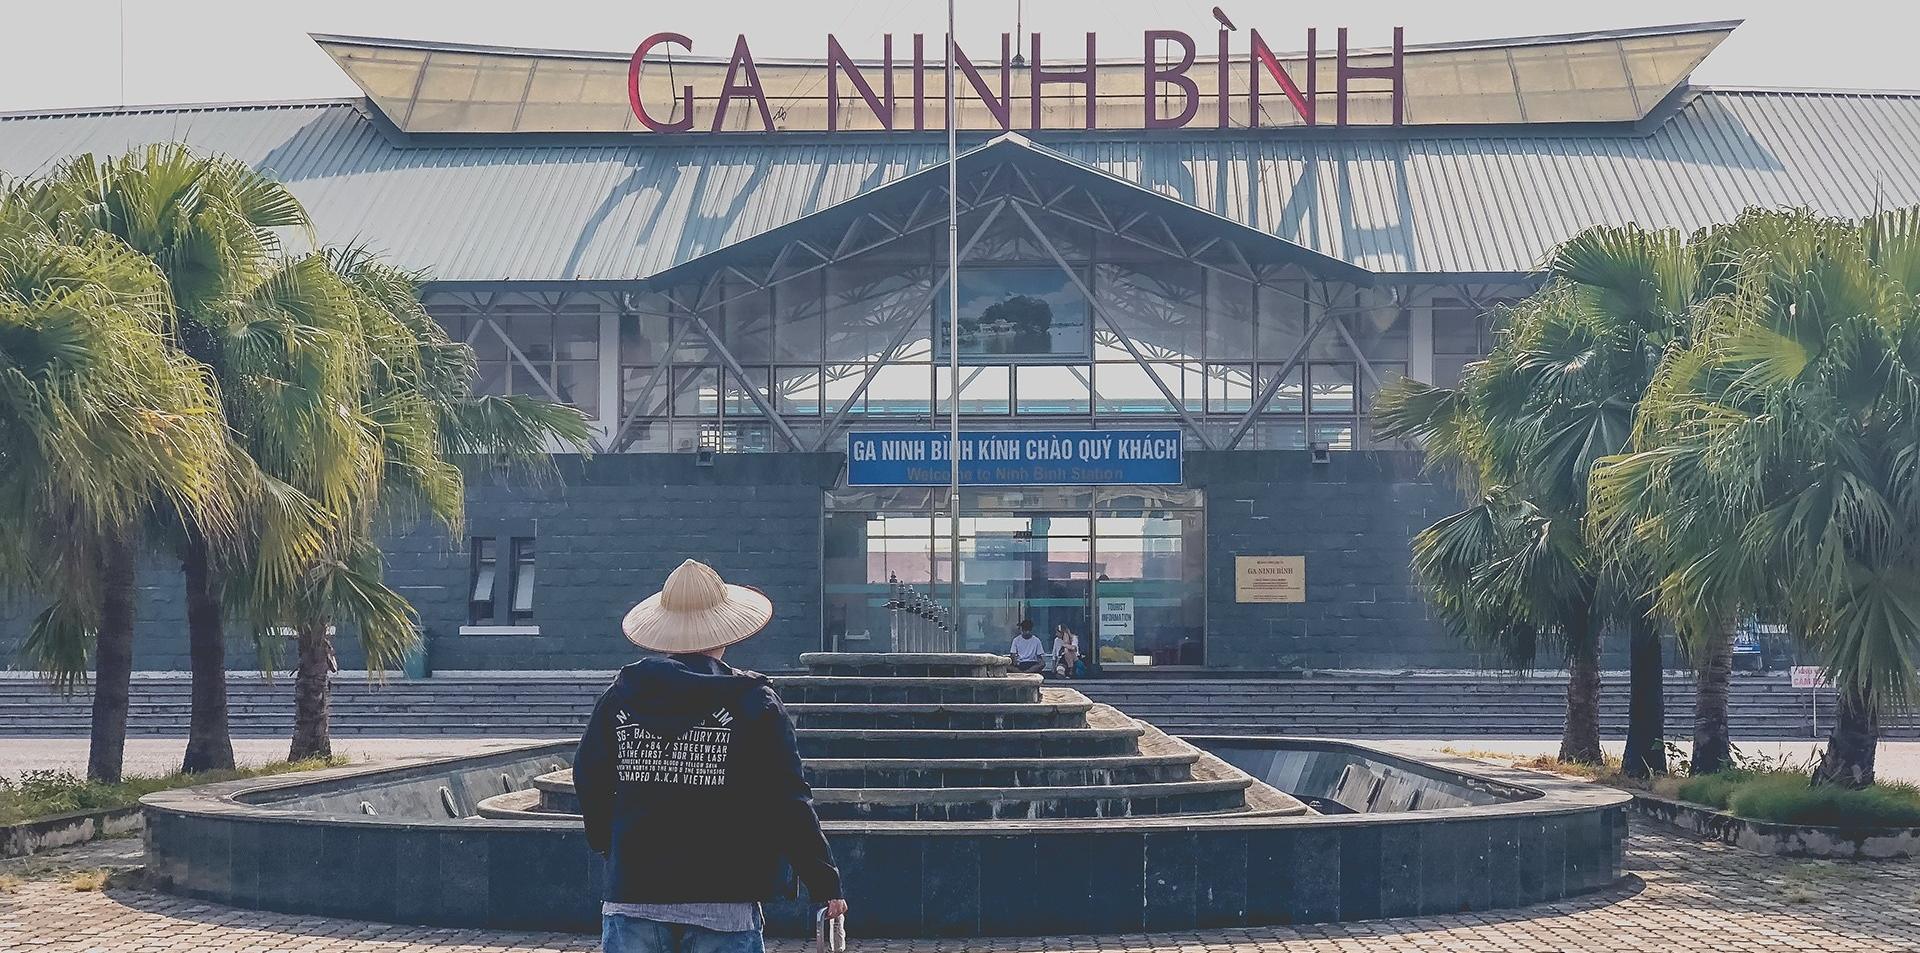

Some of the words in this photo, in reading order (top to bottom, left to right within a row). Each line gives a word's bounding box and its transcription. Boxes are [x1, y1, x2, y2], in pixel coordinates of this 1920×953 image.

[628, 32, 776, 133] GA
[827, 33, 1096, 132] NINH
[1144, 6, 1403, 130] BÌNH
[853, 440, 876, 461] GA
[882, 440, 925, 461] NINH
[978, 435, 1020, 461] KÍNH
[1026, 434, 1073, 460] CHÀO
[1078, 434, 1112, 462] QUÝ
[1118, 434, 1177, 460] KHÁCH
[977, 468, 991, 481] to
[996, 466, 1029, 480] Ninh
[1072, 466, 1123, 480] Station
[714, 731, 731, 744] XXI
[645, 741, 661, 750] +84
[673, 742, 728, 754] STREETWEAR
[640, 750, 663, 759] FIRST
[671, 751, 687, 760] NOR
[690, 752, 704, 761] THE
[707, 754, 727, 763] LAST
[654, 773, 678, 783] A.K.A
[683, 774, 726, 785] VIETNAM
